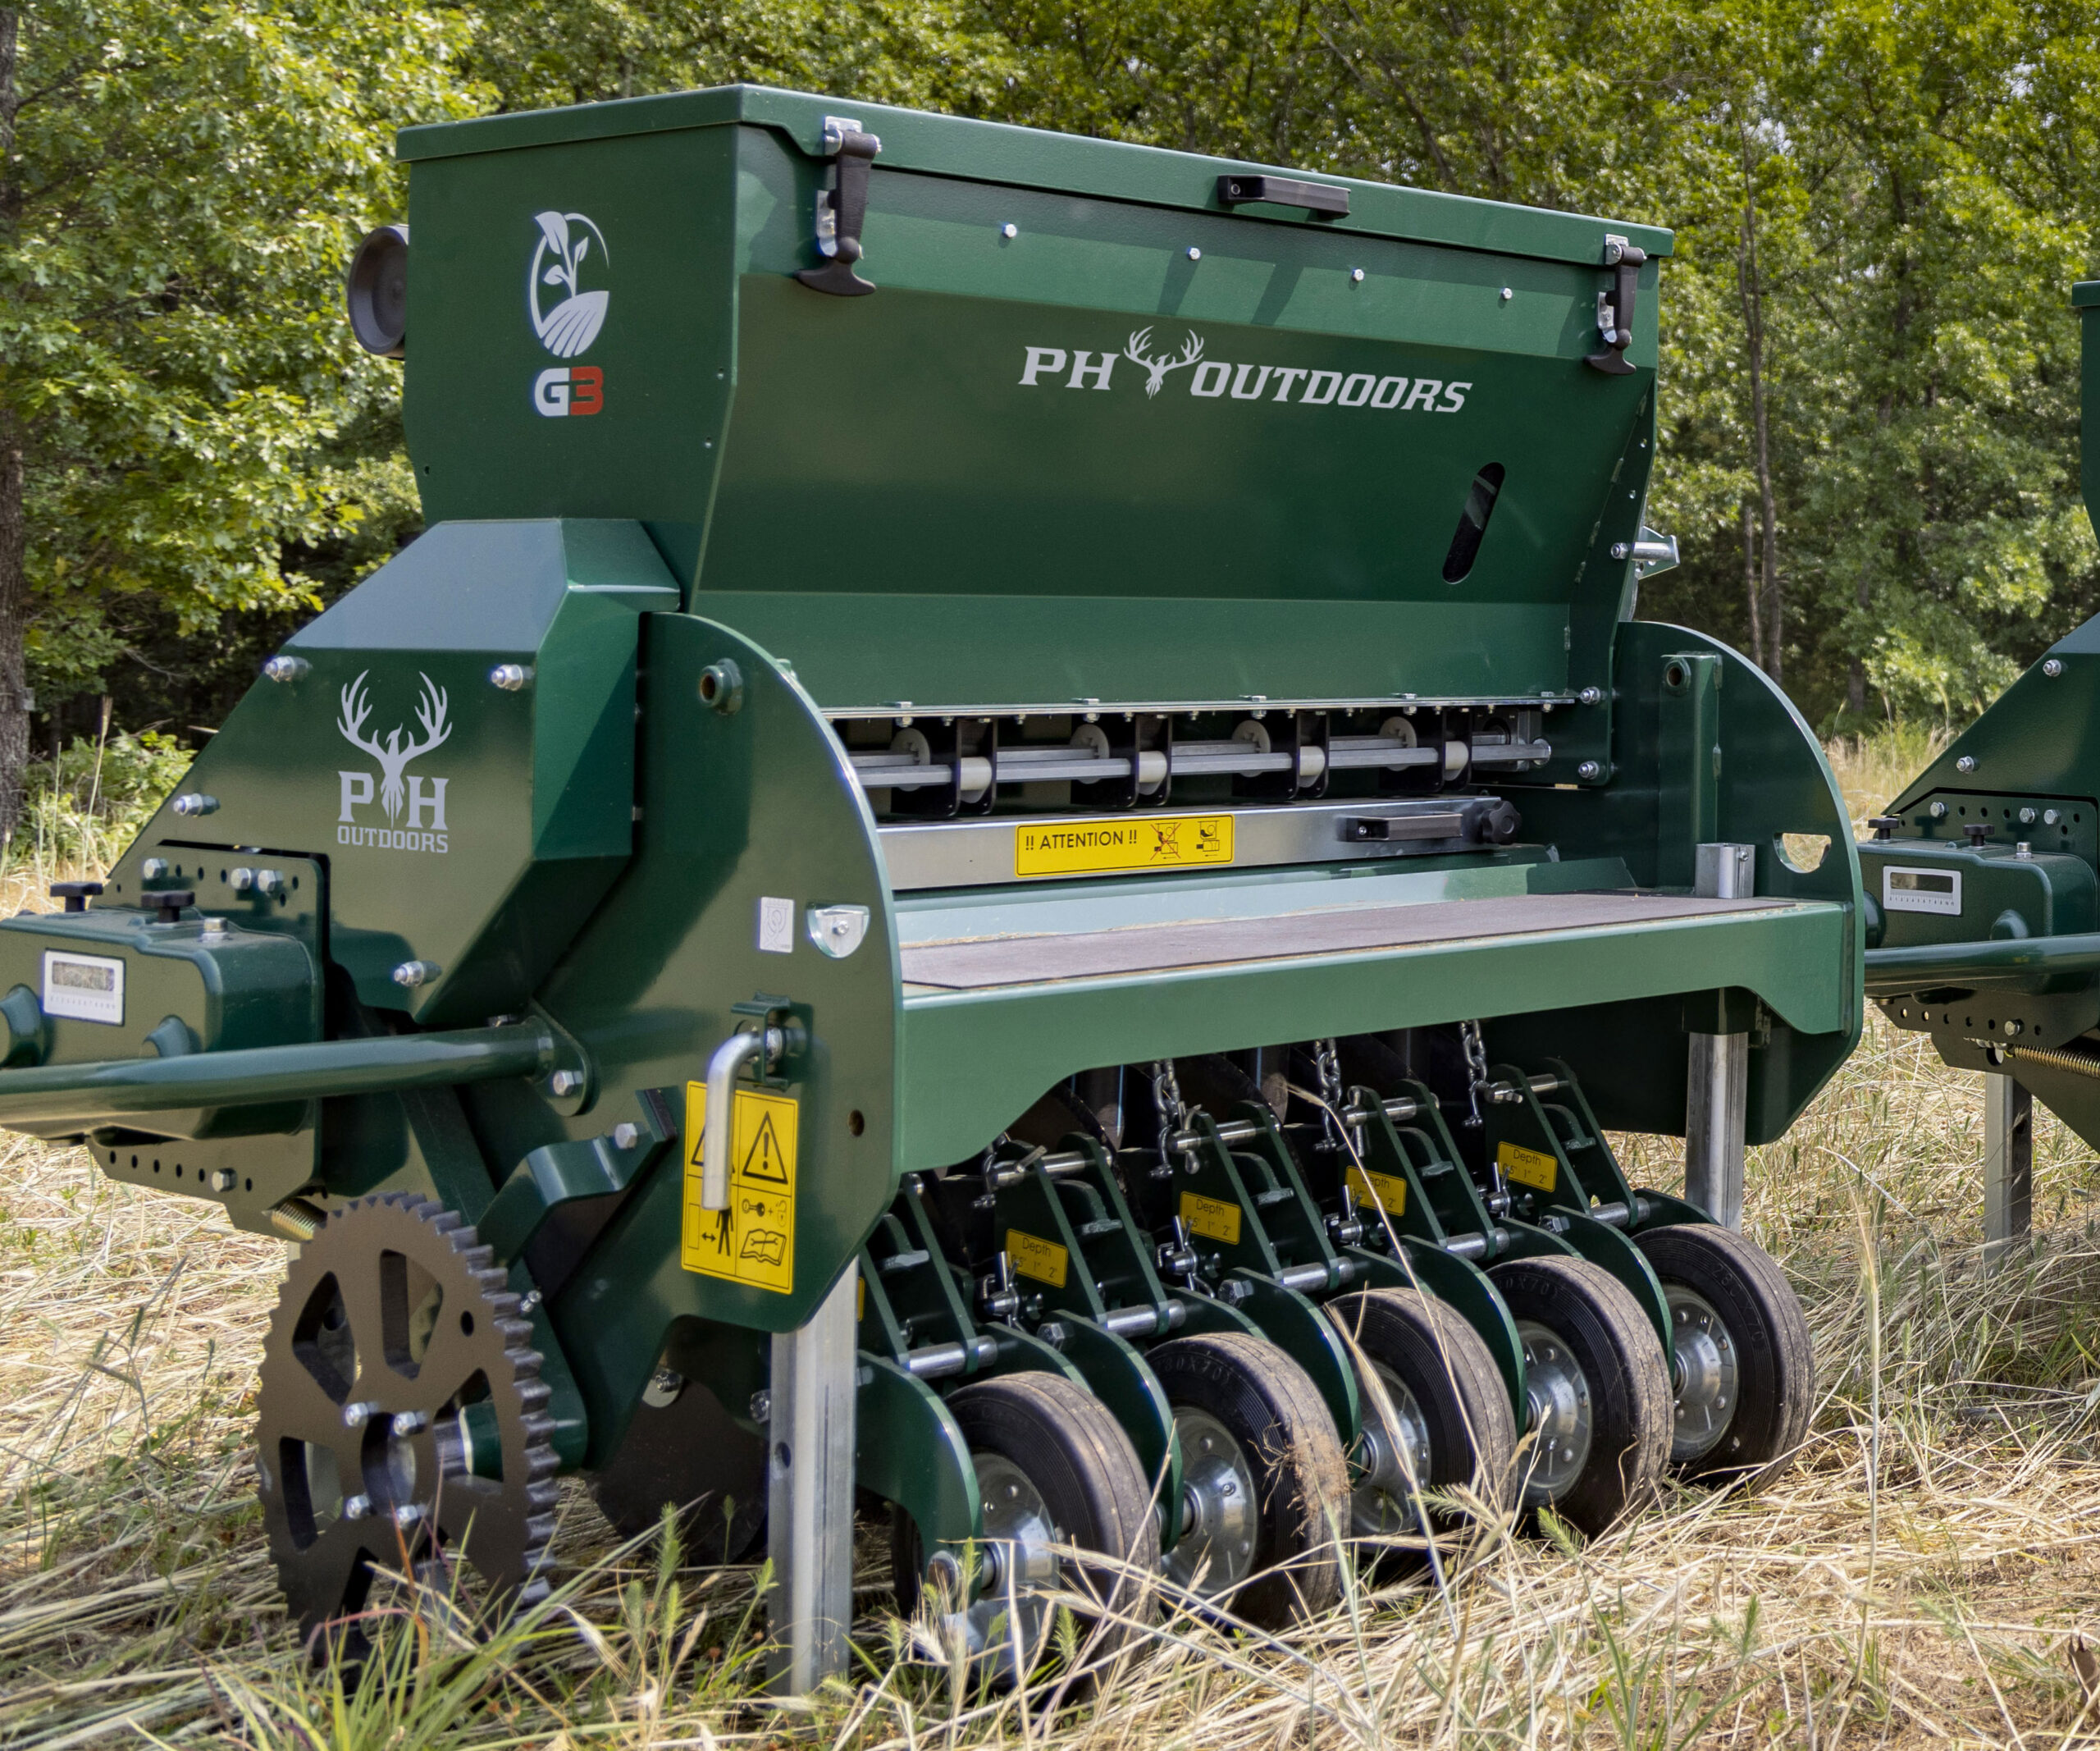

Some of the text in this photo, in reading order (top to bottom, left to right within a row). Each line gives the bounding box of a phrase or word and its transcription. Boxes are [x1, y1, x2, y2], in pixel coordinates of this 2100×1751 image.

[1018, 345, 1473, 414] PH OUTDOORS
[534, 366, 604, 417] G3
[337, 825, 448, 853] OUTDOORS
[1025, 830, 1138, 851] !! ATTENTION !!
[1513, 1149, 1541, 1166] Depth
[1196, 1198, 1225, 1217] Depth
[1022, 1237, 1051, 1257] Depth
